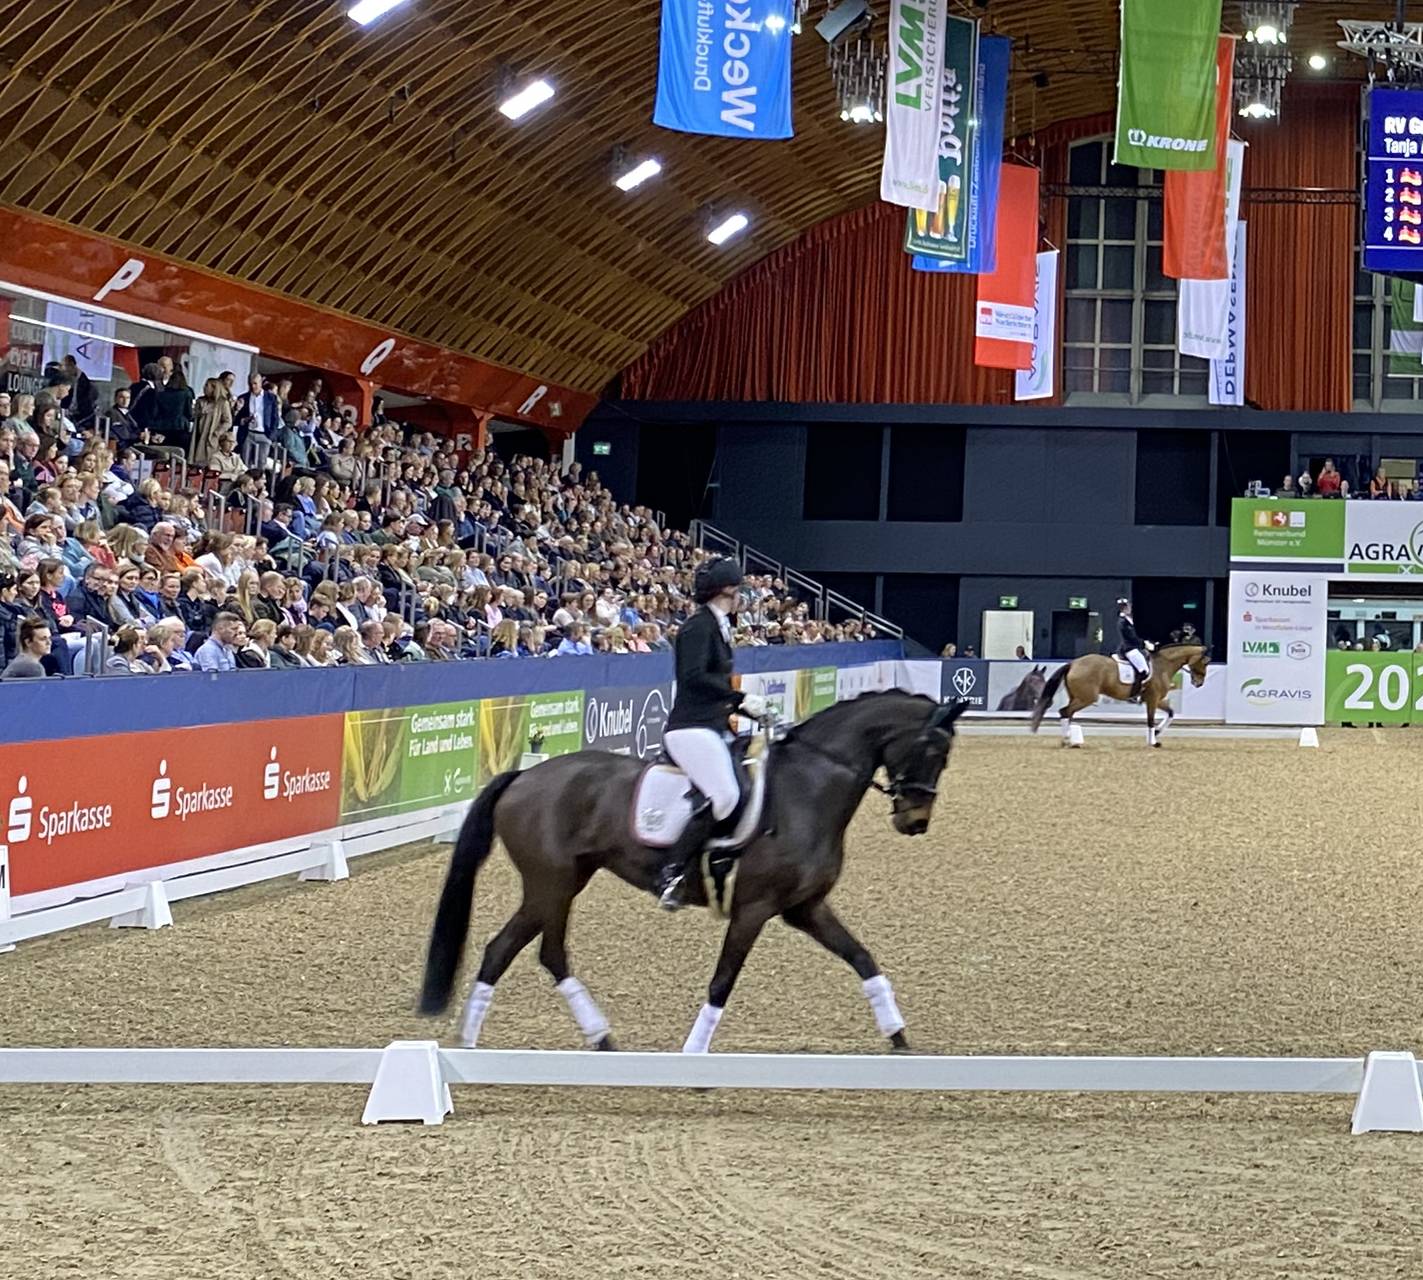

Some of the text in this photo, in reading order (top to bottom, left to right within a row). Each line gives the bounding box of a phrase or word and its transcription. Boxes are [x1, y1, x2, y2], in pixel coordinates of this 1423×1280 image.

[895, 4, 925, 110] LVM
[1384, 116, 1407, 135] RV
[1146, 135, 1208, 152] KRONE
[1384, 137, 1418, 158] Tanja
[1385, 168, 1395, 184] 1
[1385, 187, 1395, 203] 2
[1384, 206, 1394, 223] 3
[1383, 226, 1393, 242] 4
[93, 258, 145, 301] P
[1262, 583, 1312, 597] Knubel
[1242, 640, 1268, 653] LVM
[1246, 689, 1312, 699] AGRAVIS
[411, 711, 456, 734] Gemeinsam
[600, 699, 634, 738] Knubel
[422, 735, 439, 755] Land
[283, 767, 331, 802] Sparkasse
[175, 781, 233, 822] Sparkasse
[38, 801, 112, 845] Sparkasse
